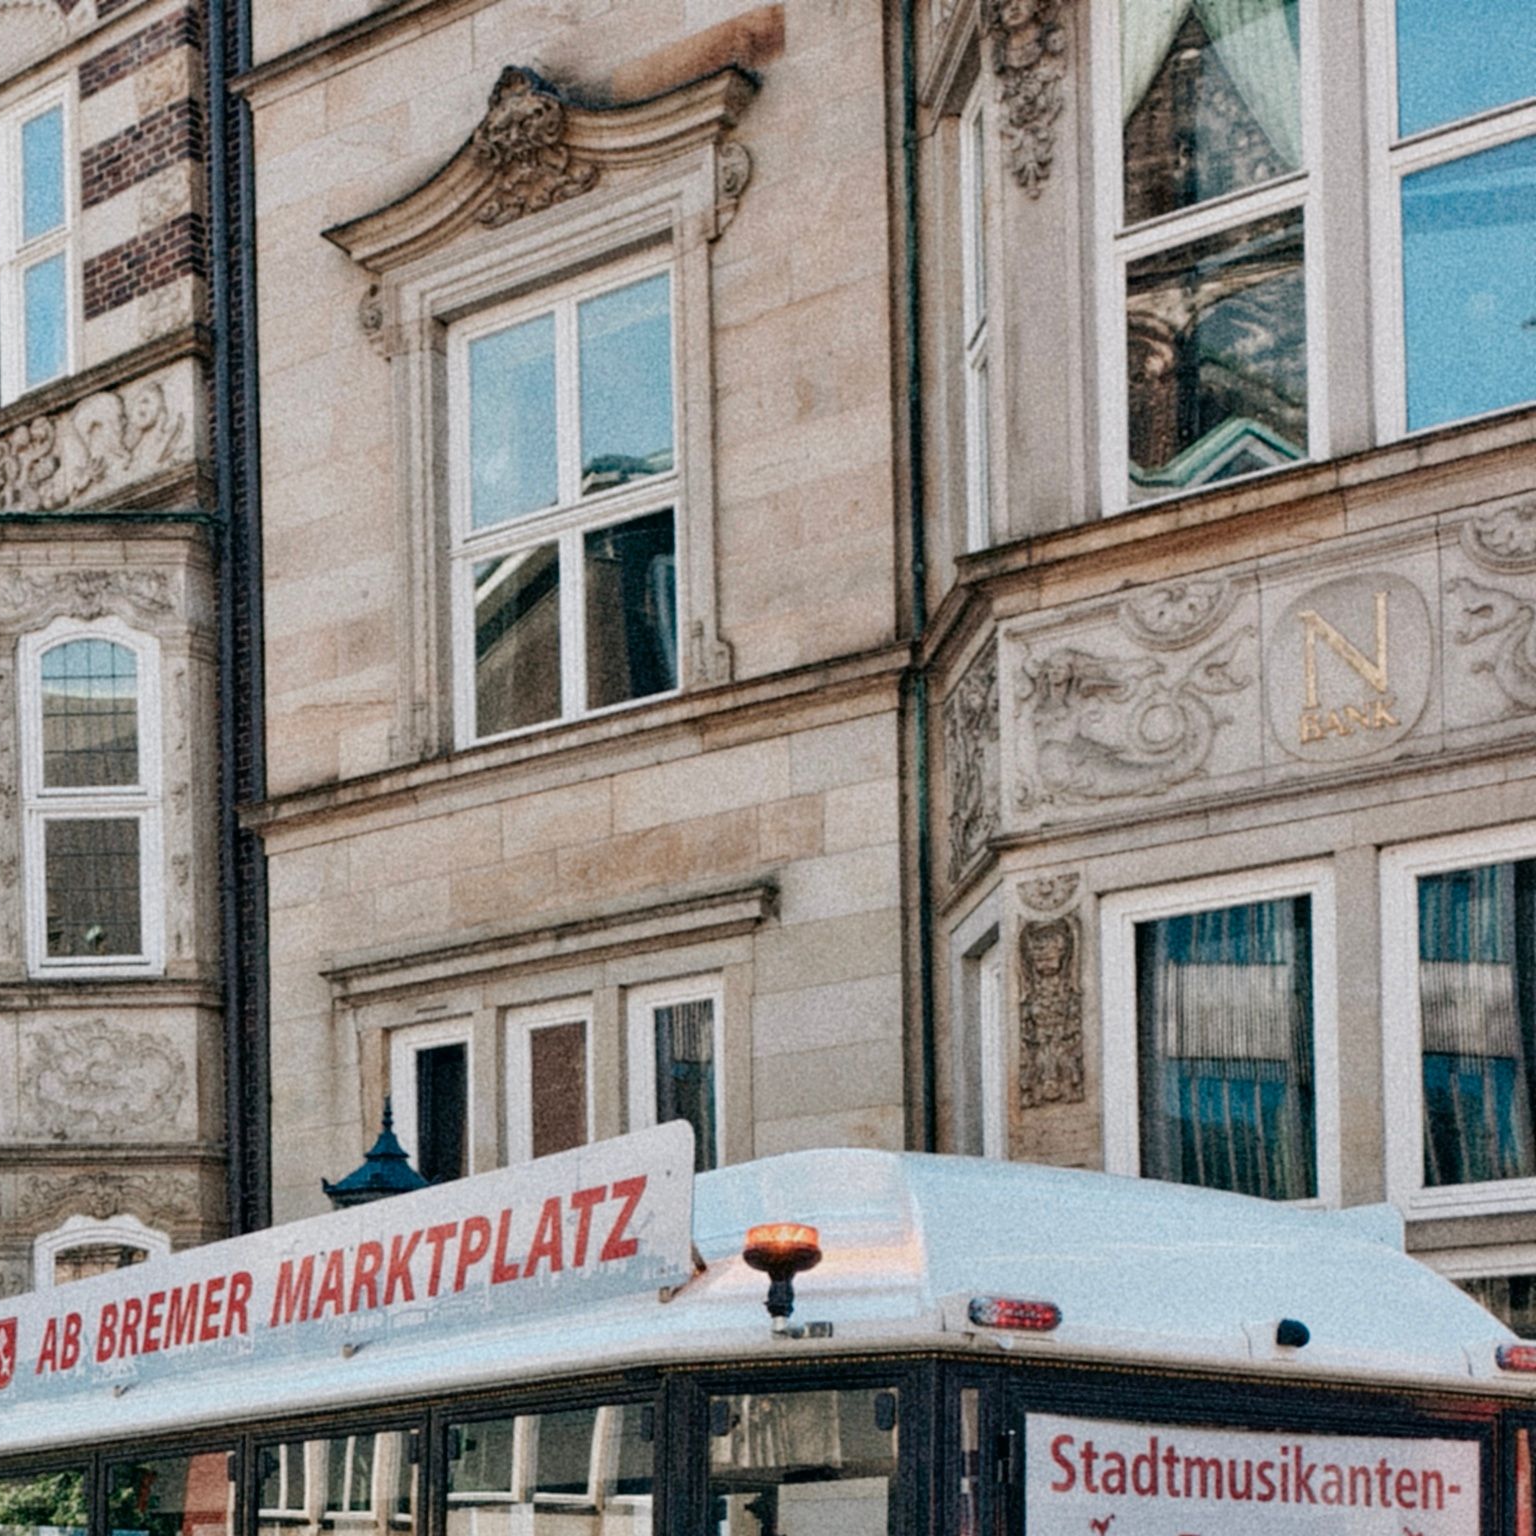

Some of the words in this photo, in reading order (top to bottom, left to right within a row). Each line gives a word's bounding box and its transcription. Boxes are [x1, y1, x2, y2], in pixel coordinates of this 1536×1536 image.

[1296, 590, 1392, 709] N
[1300, 699, 1401, 744] BANK
[36, 1317, 81, 1376] AB
[96, 1270, 253, 1363] BREMER
[270, 1175, 648, 1328] MARKTPLATZ
[1050, 1434, 1462, 1511] Stadtmusikanten-
